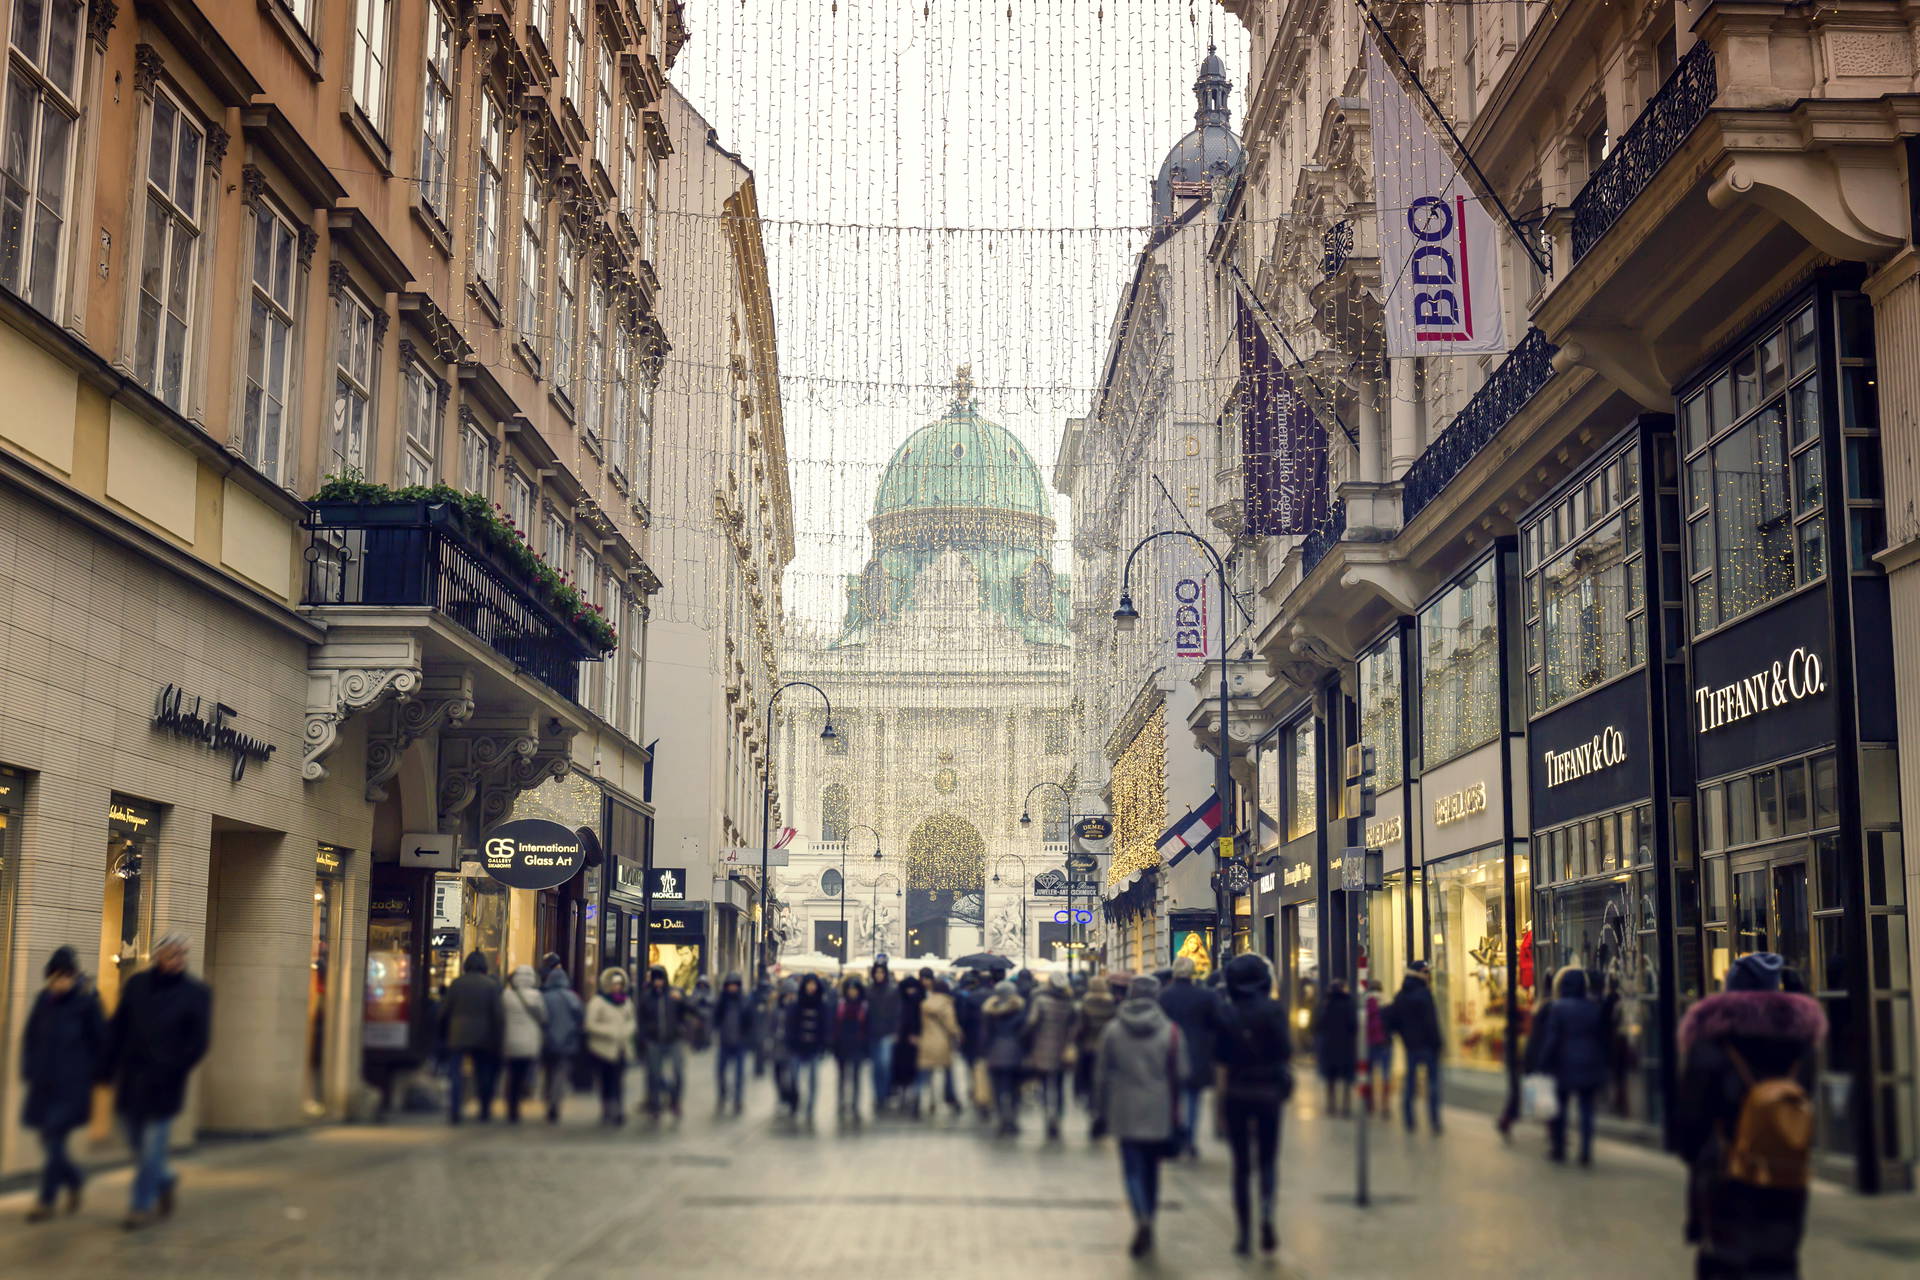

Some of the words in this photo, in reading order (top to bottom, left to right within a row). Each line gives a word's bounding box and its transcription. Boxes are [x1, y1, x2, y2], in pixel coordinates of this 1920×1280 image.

[1408, 196, 1459, 326] BDO
[1175, 579, 1201, 649] BDO
[485, 838, 515, 859] GS
[519, 842, 579, 853] International
[524, 855, 554, 866] Glass
[556, 856, 573, 867] Art
[663, 918, 685, 929] Dutti
